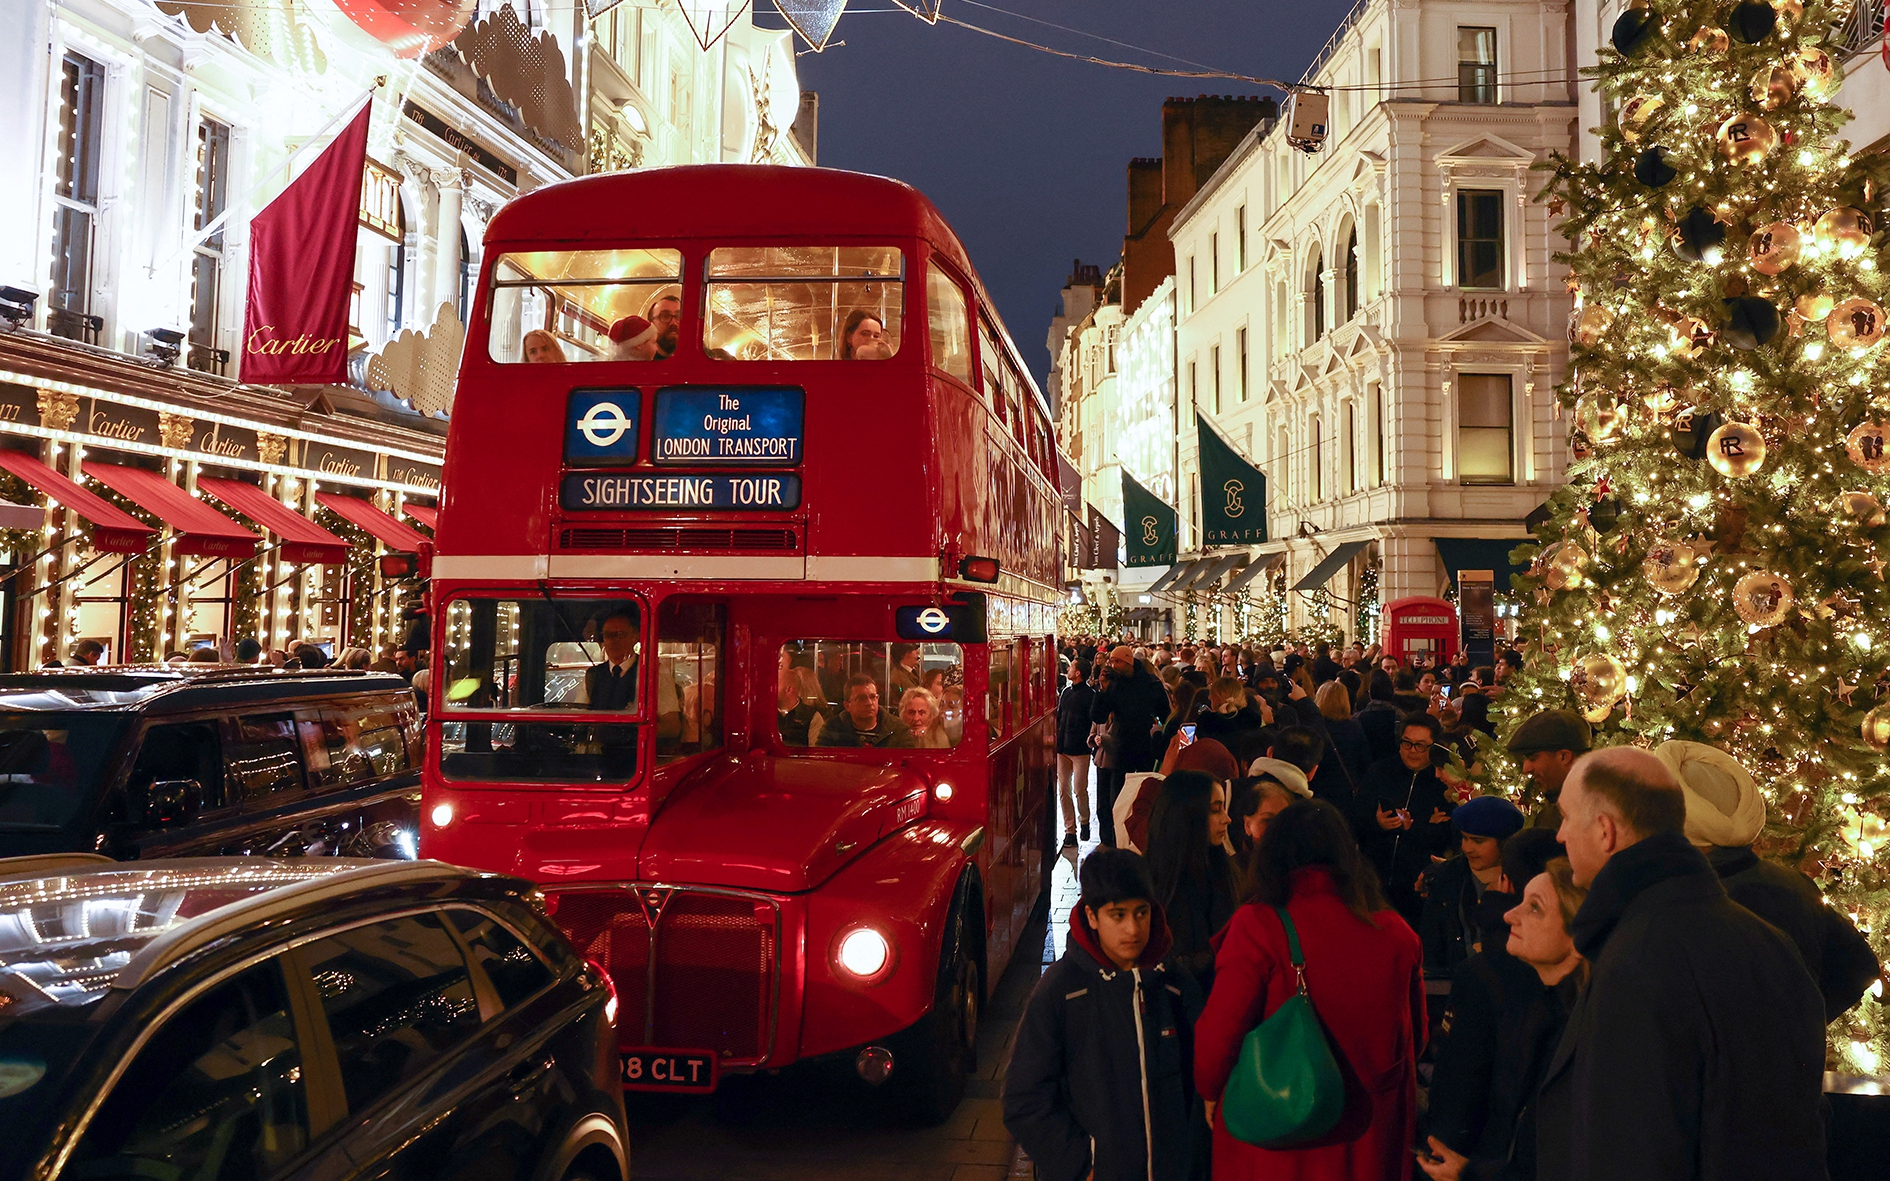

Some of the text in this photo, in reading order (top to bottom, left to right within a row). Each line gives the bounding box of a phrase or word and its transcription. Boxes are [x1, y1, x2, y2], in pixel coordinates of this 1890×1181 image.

[444, 126, 473, 155] Cartier
[247, 325, 341, 355] Cartier
[718, 394, 740, 410] The
[91, 411, 145, 440] Cartier
[704, 415, 752, 434] Original
[200, 431, 246, 457] Cartier
[656, 437, 798, 460] LONDON TRANSPORT
[319, 451, 361, 477] Cartier
[405, 467, 439, 489] Cartier
[582, 478, 782, 505] SIGHTSEEING TOUR
[104, 533, 135, 547] Cartier
[202, 538, 229, 551] Cartier
[1207, 528, 1262, 540] GRAFF
[302, 547, 324, 559] Cartier
[1130, 553, 1173, 564] GRAFF
[620, 1057, 703, 1082] 8 CLT
